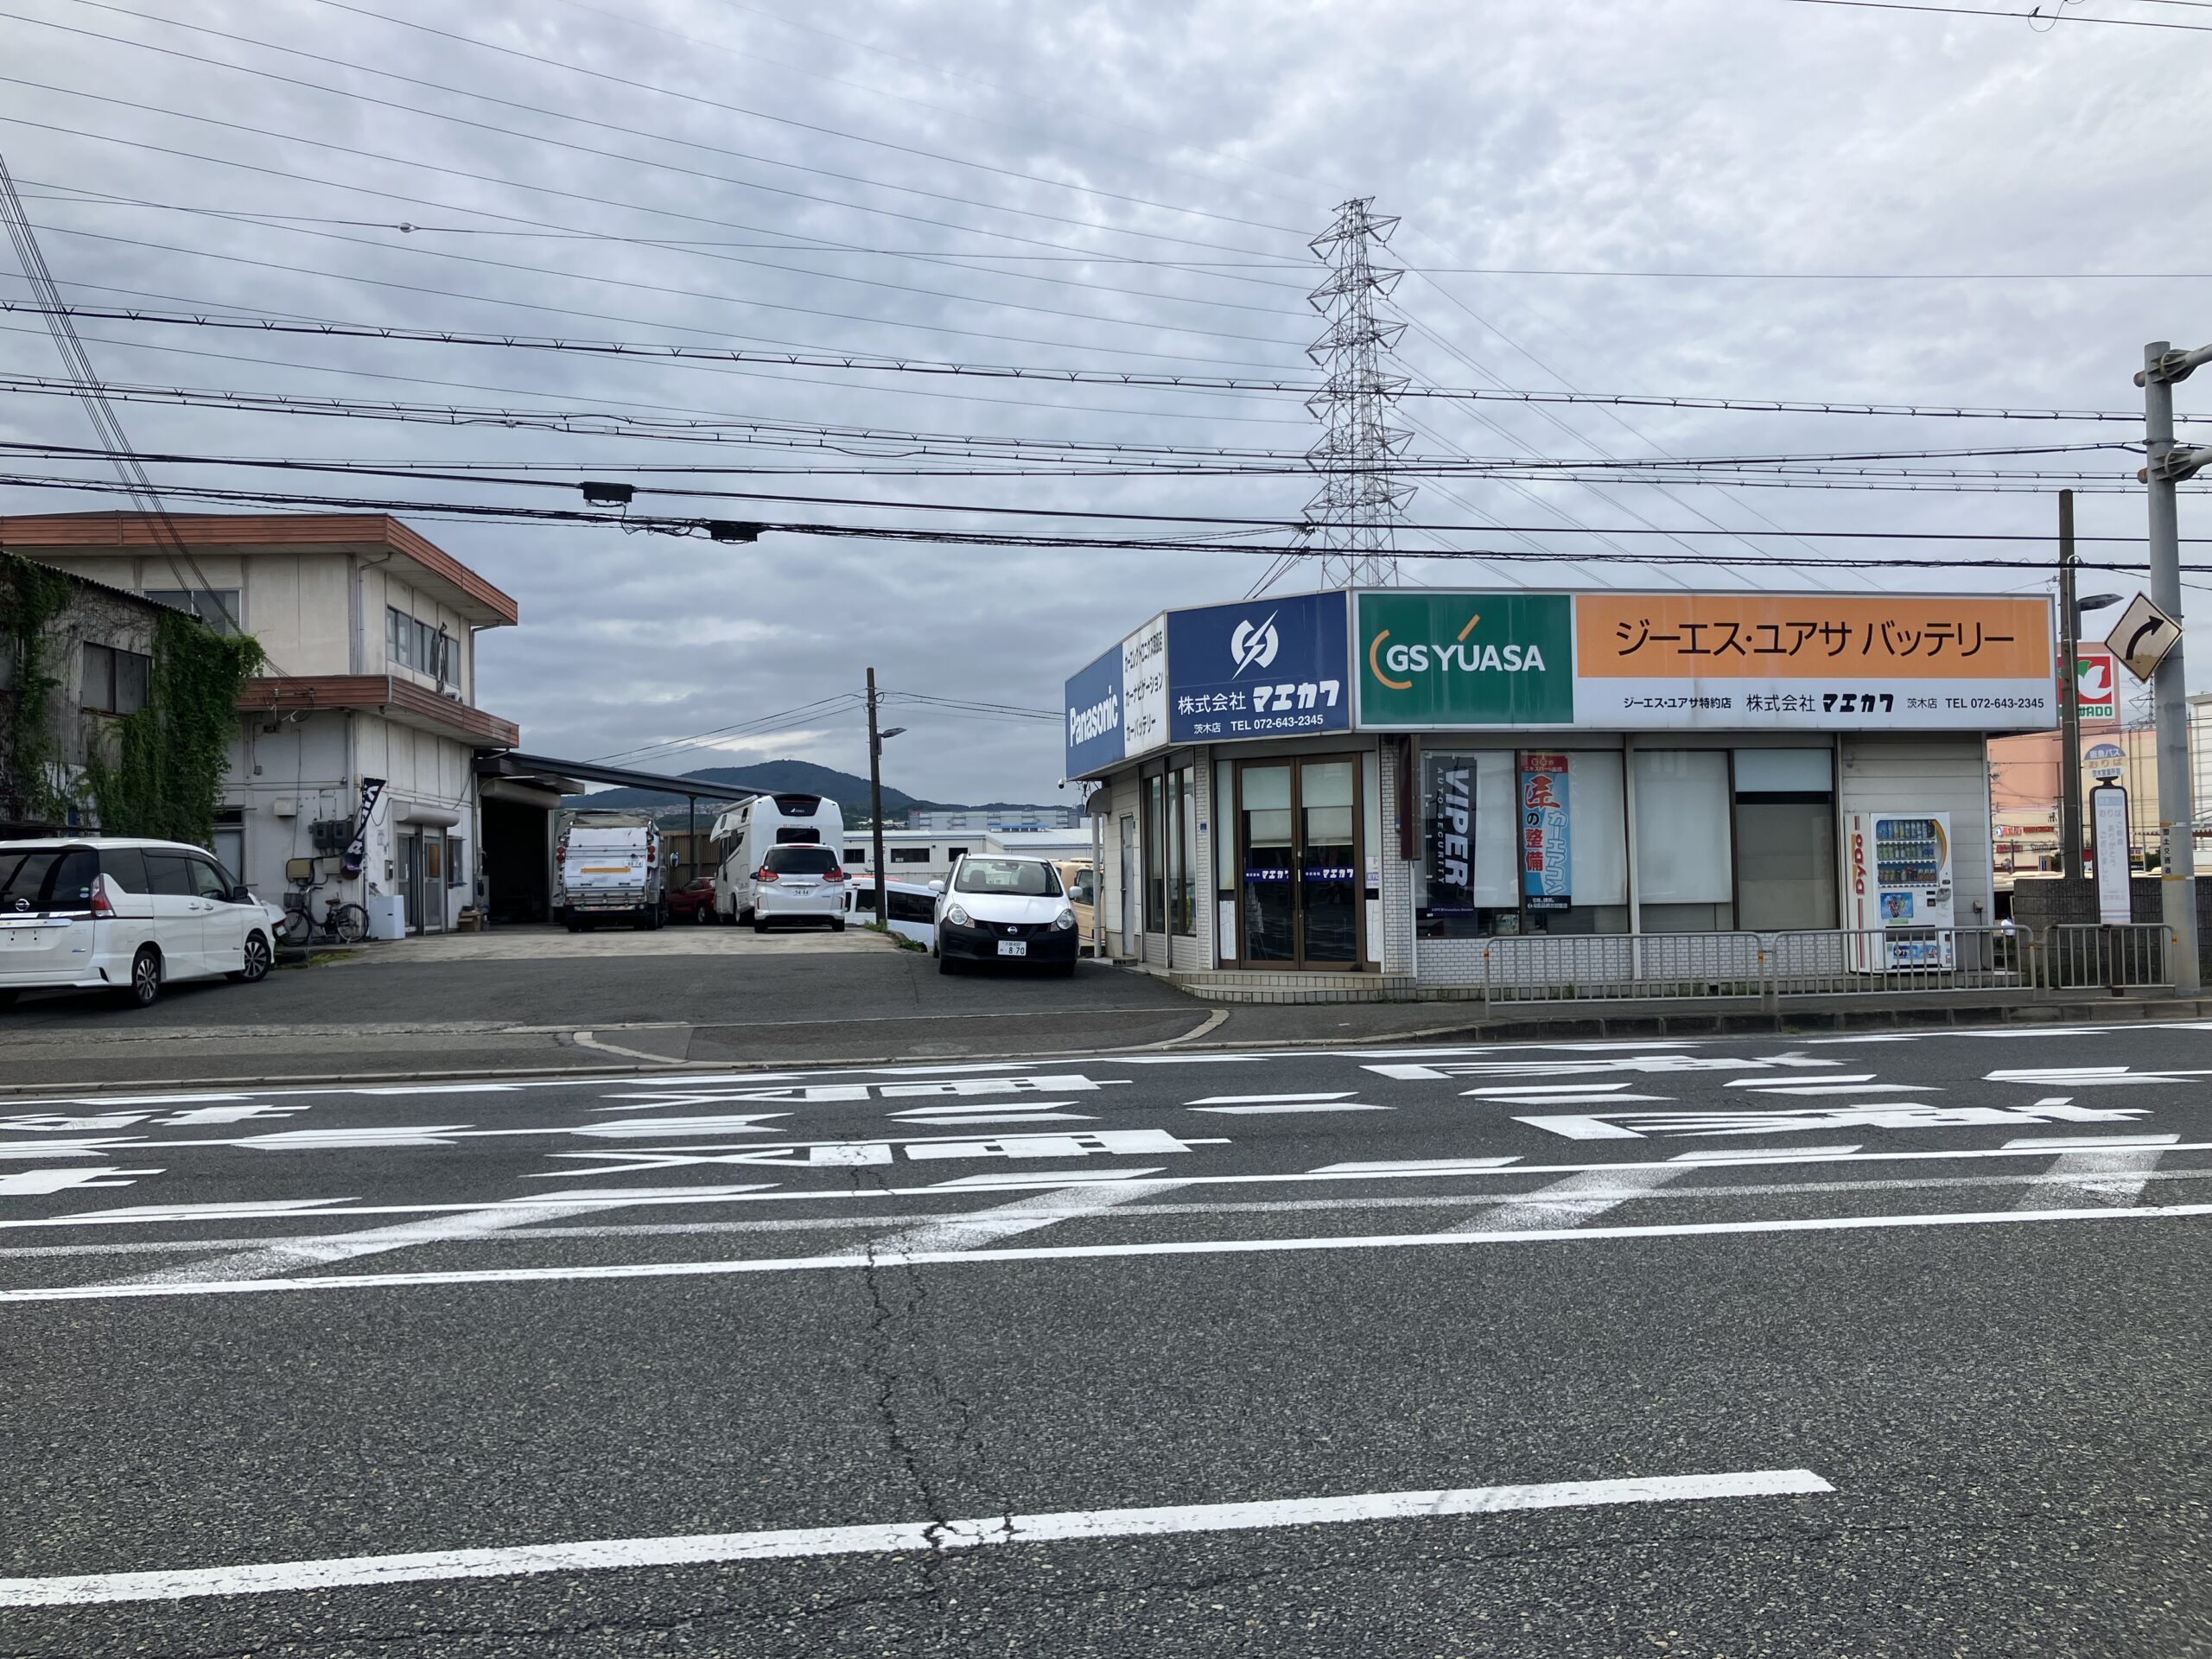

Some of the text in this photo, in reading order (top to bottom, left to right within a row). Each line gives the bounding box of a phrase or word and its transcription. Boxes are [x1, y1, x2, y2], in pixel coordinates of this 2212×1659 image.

[1862, 620, 2014, 657] バッテリー
[1126, 671, 1163, 707] カーナビゲーション
[1178, 679, 1339, 715] 株式会社 マエカワ
[1746, 694, 1815, 713] 株式会社
[1823, 693, 1894, 713] マエカワ
[1907, 698, 1938, 709] 茨木店
[1946, 698, 1967, 709] TEL
[1971, 698, 2044, 709] 072-643-2345
[1070, 684, 1119, 747] Panasonic
[1126, 714, 1156, 741] カーバッテリー
[1193, 715, 1324, 734] 茨木店 TEL 072-643-2345
[1445, 769, 1469, 887] VIPER
[1544, 810, 1567, 896] カーエアコン
